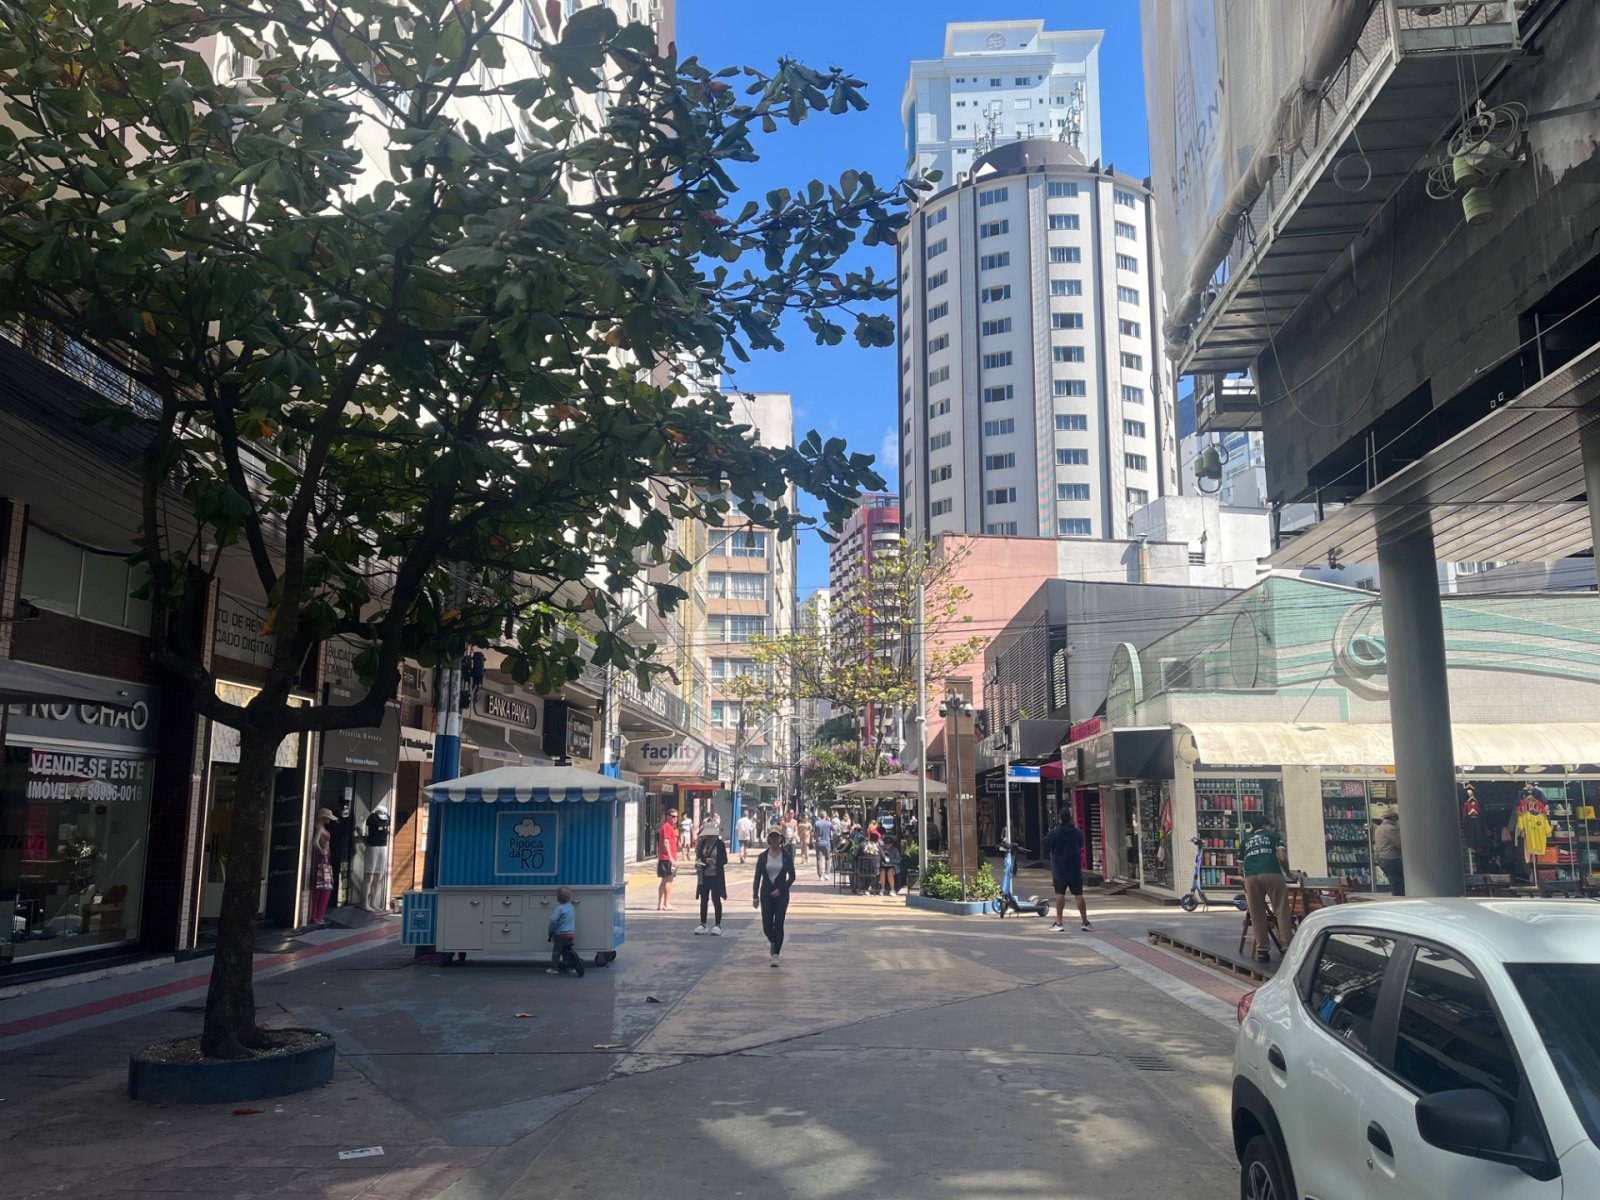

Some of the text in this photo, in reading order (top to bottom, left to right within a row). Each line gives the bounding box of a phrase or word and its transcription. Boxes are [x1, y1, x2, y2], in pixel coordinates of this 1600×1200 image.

[232, 613, 243, 628] DE
[242, 636, 274, 657] DIGITAL
[488, 696, 530, 725] BANKA PANKA
[31, 753, 107, 779] VENDE-SE
[110, 759, 145, 780] ESTE
[27, 777, 71, 800] IMÓVEL
[508, 848, 520, 858] da
[509, 838, 544, 850] Pipoca
